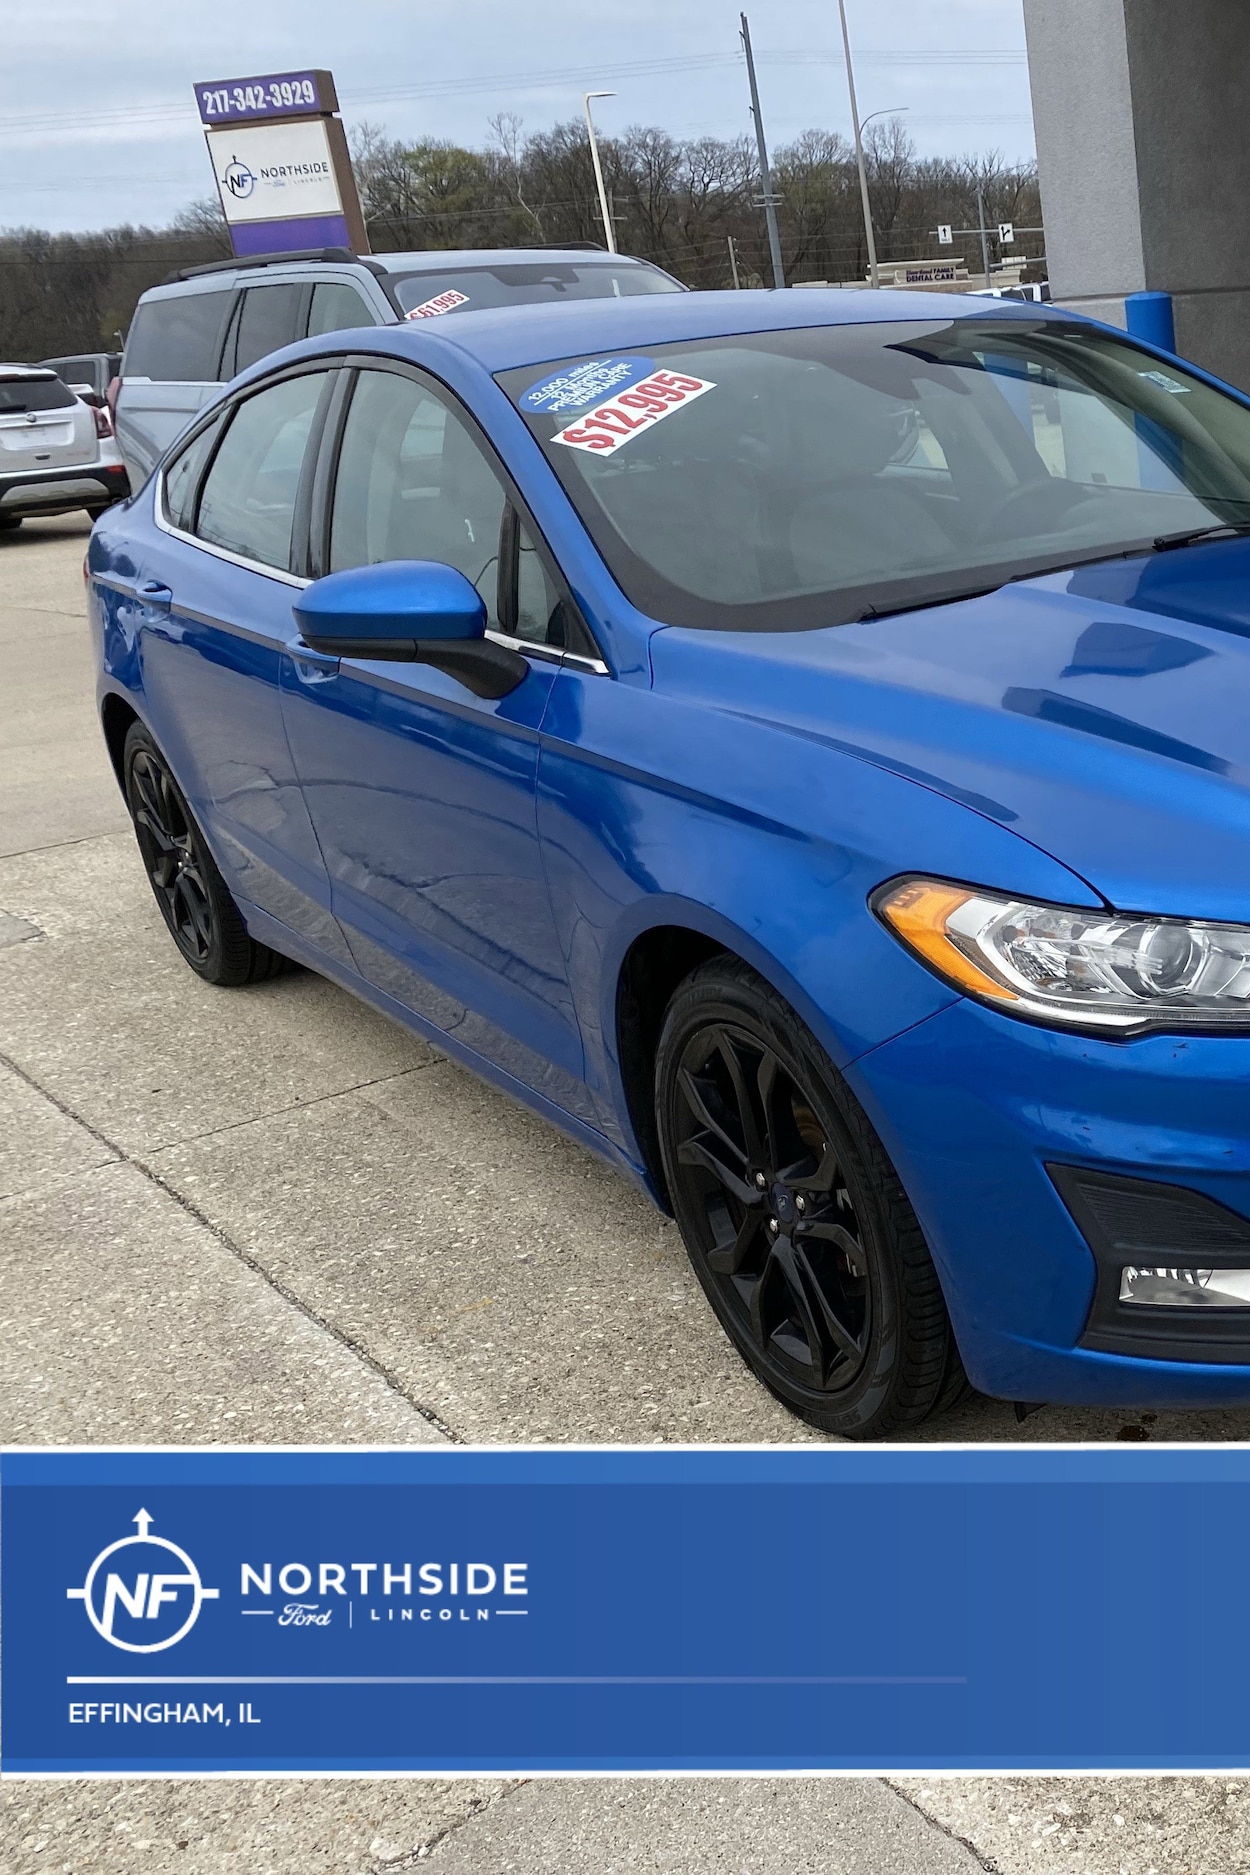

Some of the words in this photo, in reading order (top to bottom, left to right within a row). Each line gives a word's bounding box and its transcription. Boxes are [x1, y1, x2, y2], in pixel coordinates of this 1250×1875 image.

[202, 79, 315, 115] 217-342-3929
[260, 162, 329, 178] NORTHSIDE
[597, 362, 632, 381] CARE
[563, 373, 704, 450] $12,995
